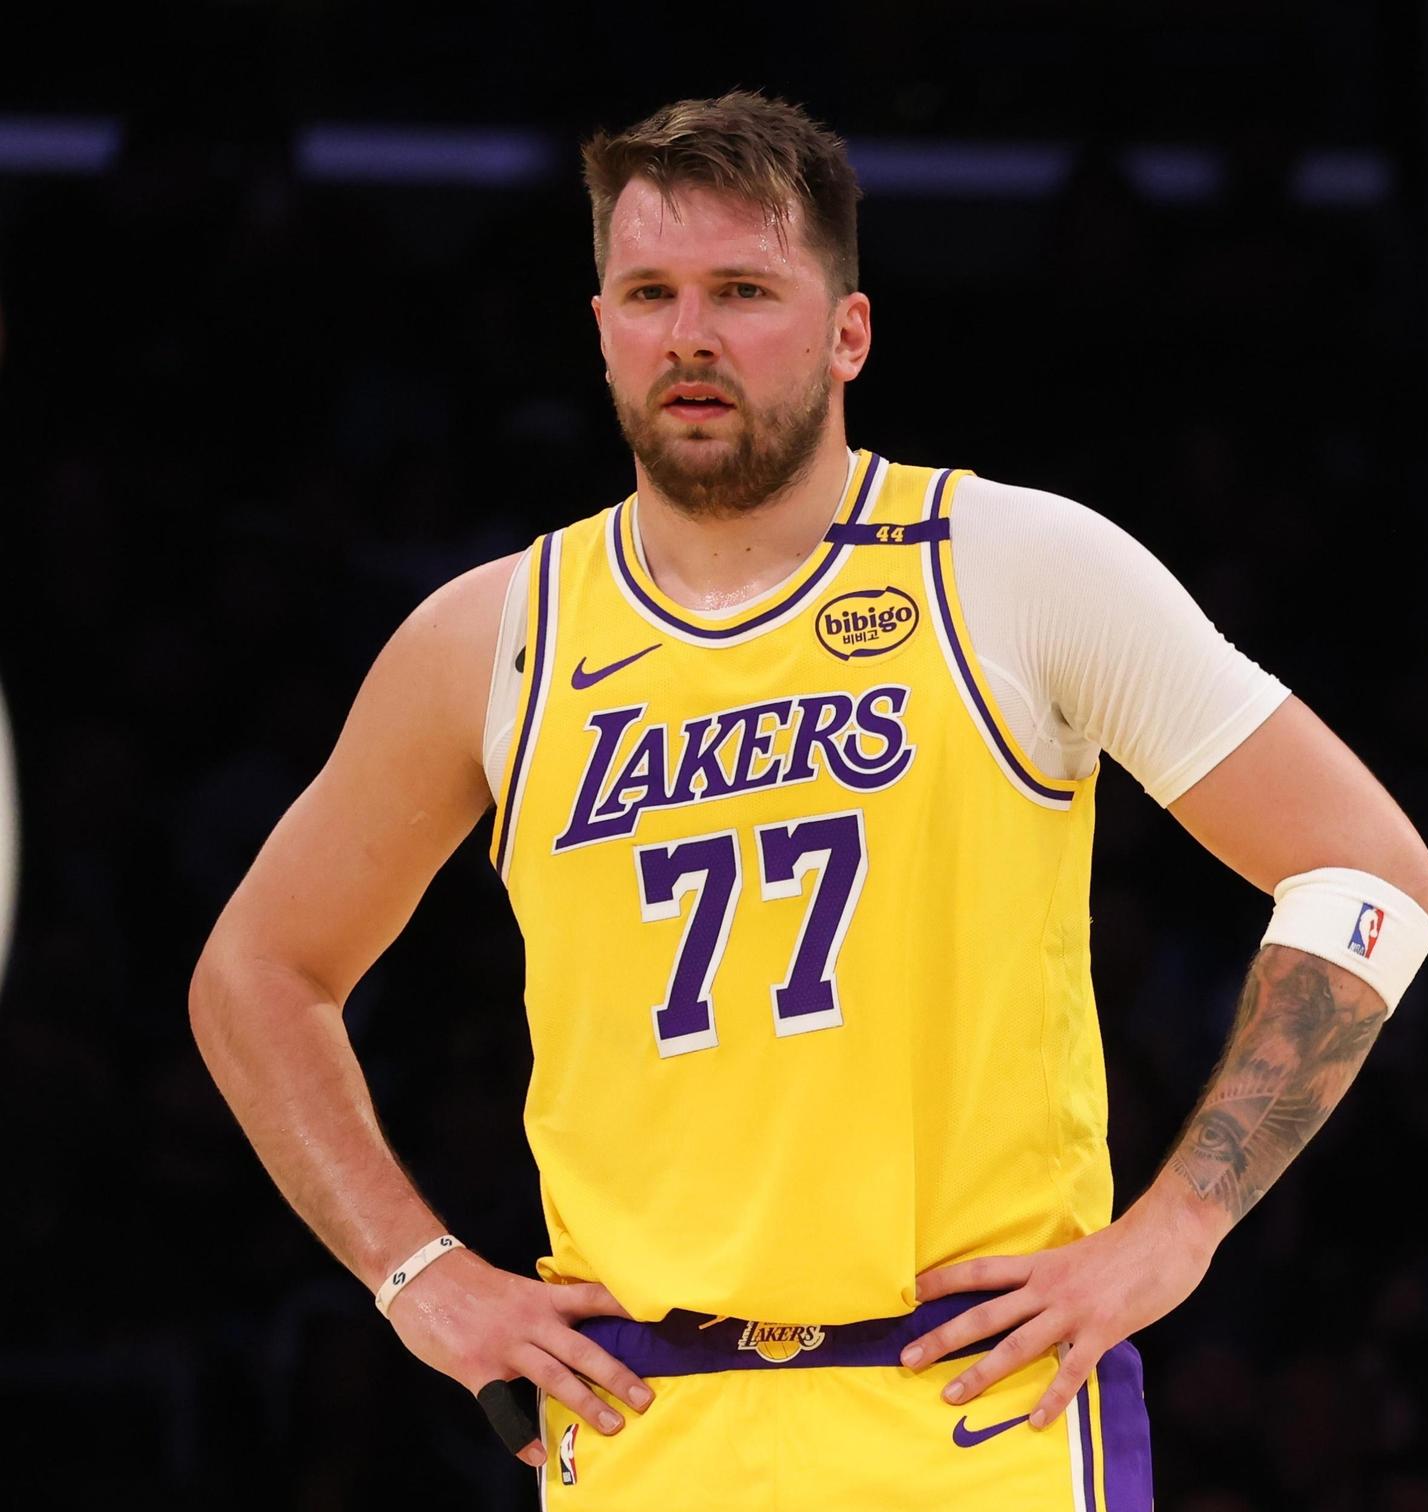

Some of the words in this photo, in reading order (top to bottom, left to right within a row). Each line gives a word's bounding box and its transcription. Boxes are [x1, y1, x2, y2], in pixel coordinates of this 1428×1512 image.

[875, 525, 905, 543] 44
[824, 605, 913, 635] bibigo
[842, 629, 880, 646] 비비고
[552, 686, 916, 854] LAKERS
[633, 809, 868, 1058] 77
[738, 1321, 825, 1350] LAKERS
